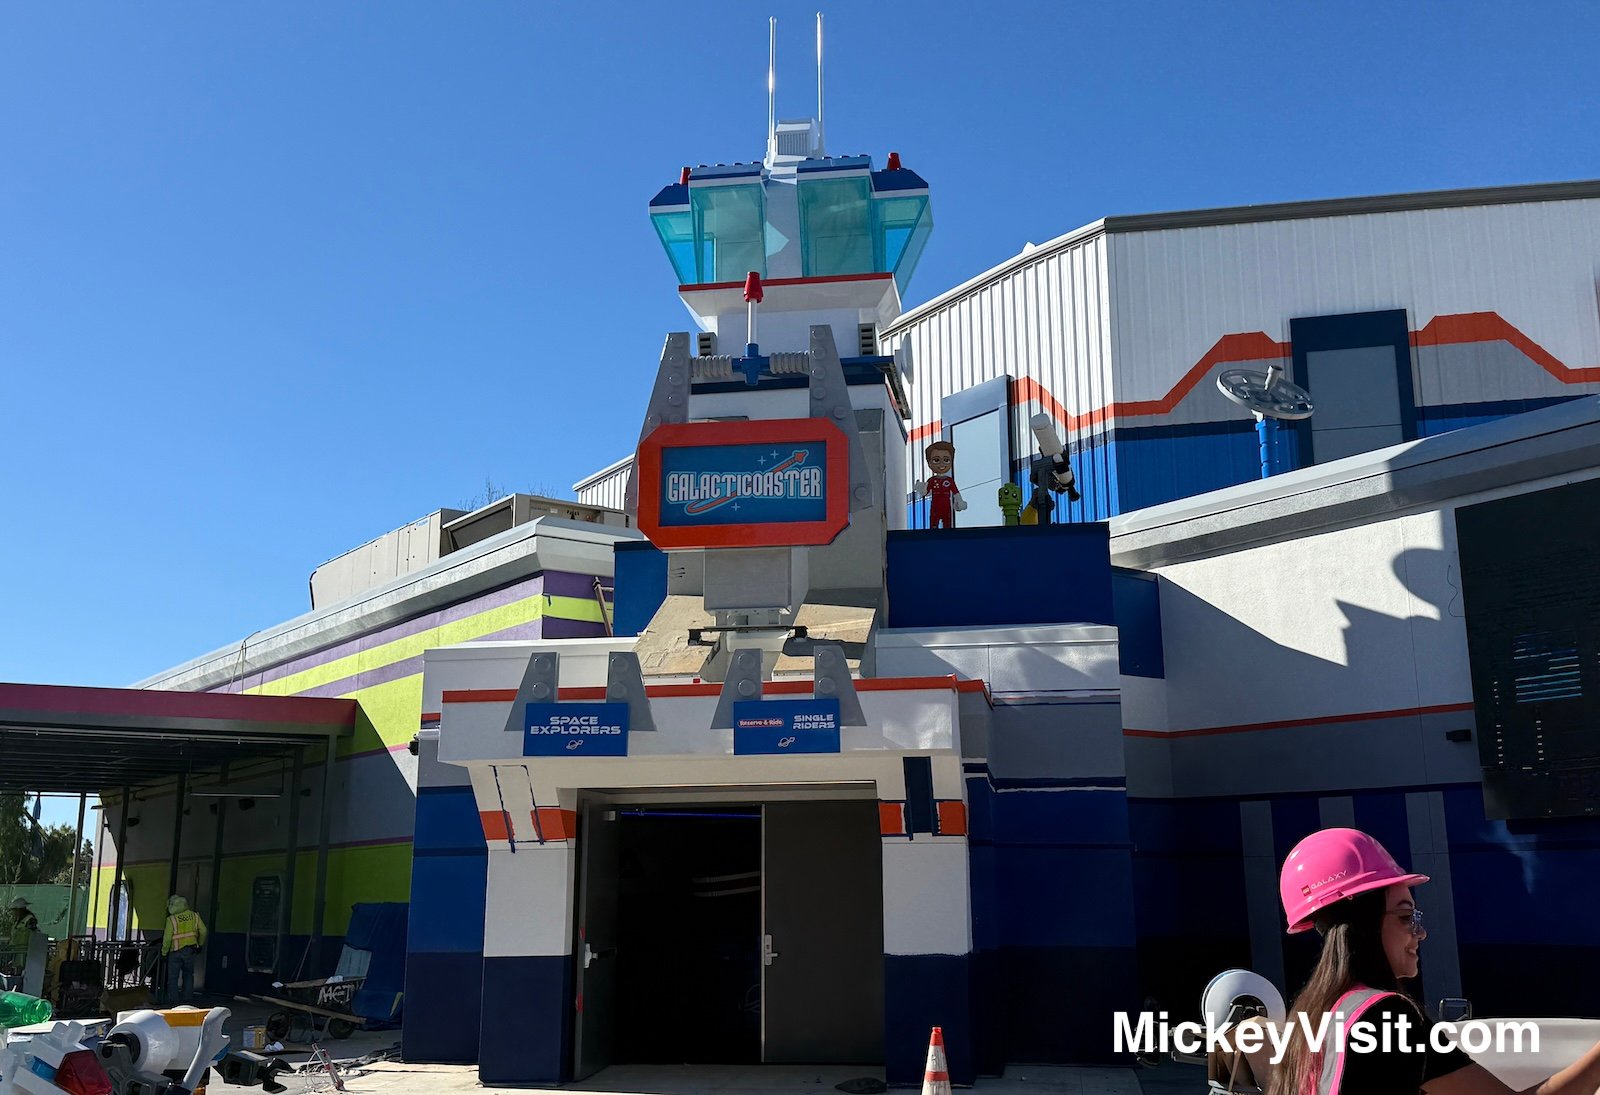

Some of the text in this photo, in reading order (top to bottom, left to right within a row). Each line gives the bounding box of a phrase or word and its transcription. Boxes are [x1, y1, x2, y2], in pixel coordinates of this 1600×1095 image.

[668, 467, 823, 502] GALACTICOASTER
[550, 716, 598, 725] SPACE
[794, 714, 834, 722] SINGLE
[793, 721, 835, 729] RIDERS
[530, 726, 621, 734] EXPLORERS
[1310, 870, 1347, 889] GALAXY
